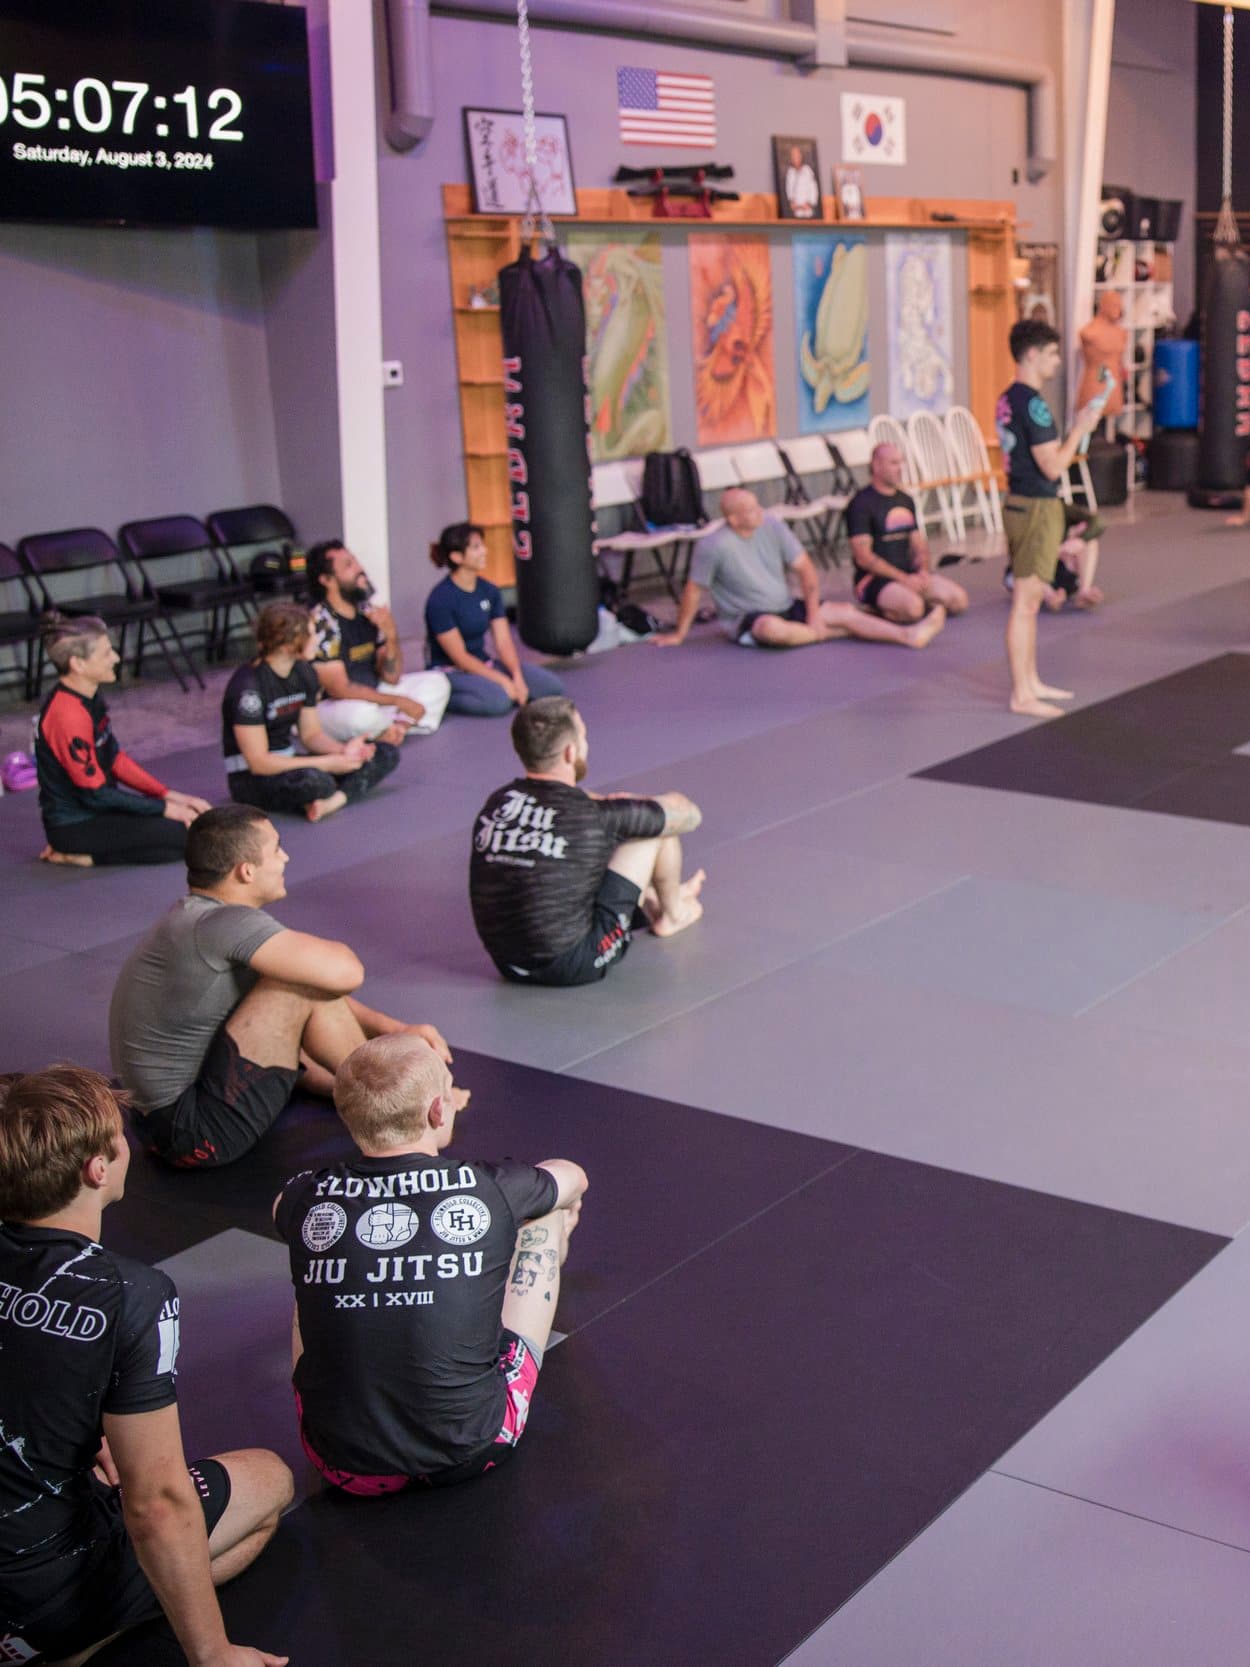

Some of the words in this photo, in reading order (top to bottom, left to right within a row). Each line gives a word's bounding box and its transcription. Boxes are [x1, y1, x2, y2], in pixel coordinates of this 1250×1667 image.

[0, 72, 244, 142] 5:07:12
[12, 142, 93, 167] Saturday,
[95, 147, 153, 169] August
[155, 151, 172, 170] 3,
[173, 151, 215, 171] 2024
[492, 790, 558, 831] Jiu
[475, 815, 570, 859] Jitsu
[303, 1258, 348, 1285] JIU
[366, 1251, 484, 1284] JITSU
[334, 1294, 366, 1309] XX
[385, 1290, 434, 1307] XVIII
